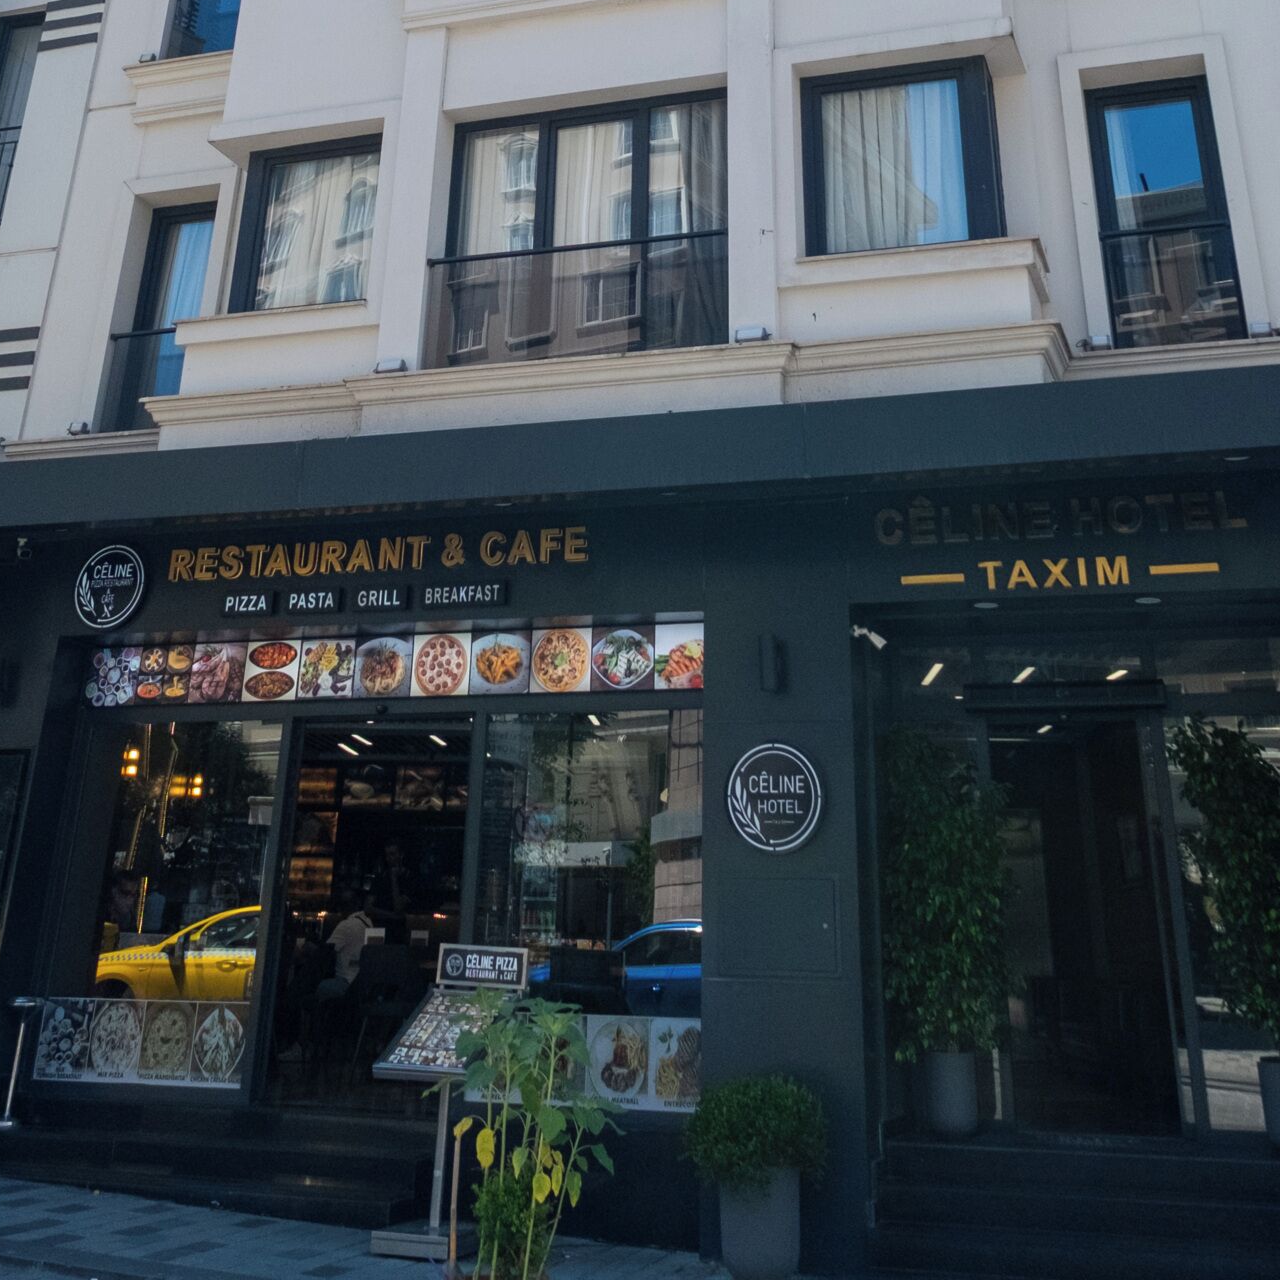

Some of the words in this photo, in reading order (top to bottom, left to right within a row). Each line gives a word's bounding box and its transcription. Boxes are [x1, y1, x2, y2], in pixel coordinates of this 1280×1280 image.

[1070, 490, 1249, 536] HOTEL
[167, 535, 434, 582] RESTAURANT
[441, 533, 467, 568] &
[479, 525, 589, 566] CAFE
[977, 555, 1130, 590] TAXIM
[225, 594, 267, 612] PIZZA
[289, 591, 335, 610] PASTA
[357, 587, 401, 607] GRILL
[424, 583, 500, 604] BREAKFAST
[758, 799, 803, 814] HOTEL
[465, 969, 499, 979] RESTAURANT
[496, 956, 518, 970] PIZZA
